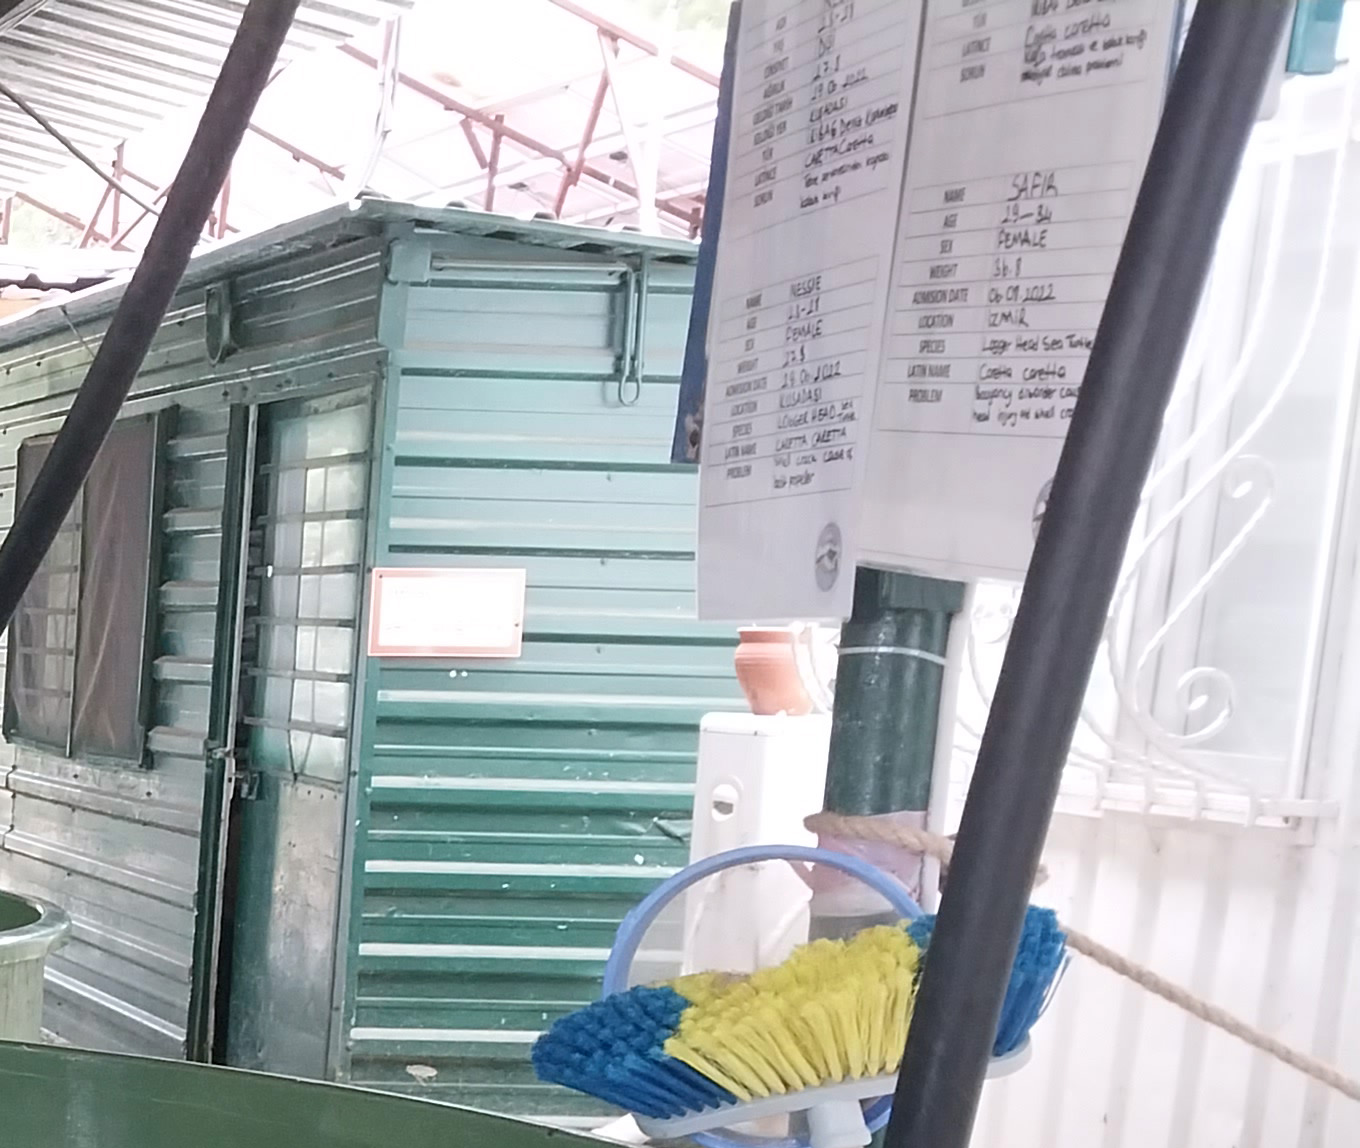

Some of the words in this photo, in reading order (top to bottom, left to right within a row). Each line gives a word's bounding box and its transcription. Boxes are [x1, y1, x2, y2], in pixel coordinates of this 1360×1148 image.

[943, 187, 966, 204] NAME
[942, 213, 958, 229] AGE
[940, 239, 953, 254] SEX
[997, 229, 1048, 250] FEMALE
[929, 263, 959, 281] WEIGHT
[948, 288, 968, 303] DATE
[918, 314, 955, 329] LOCATION
[919, 339, 946, 354] SPECIES
[907, 364, 927, 379] LATIN
[928, 363, 951, 379] NAME
[908, 388, 943, 403] PROBLEM
